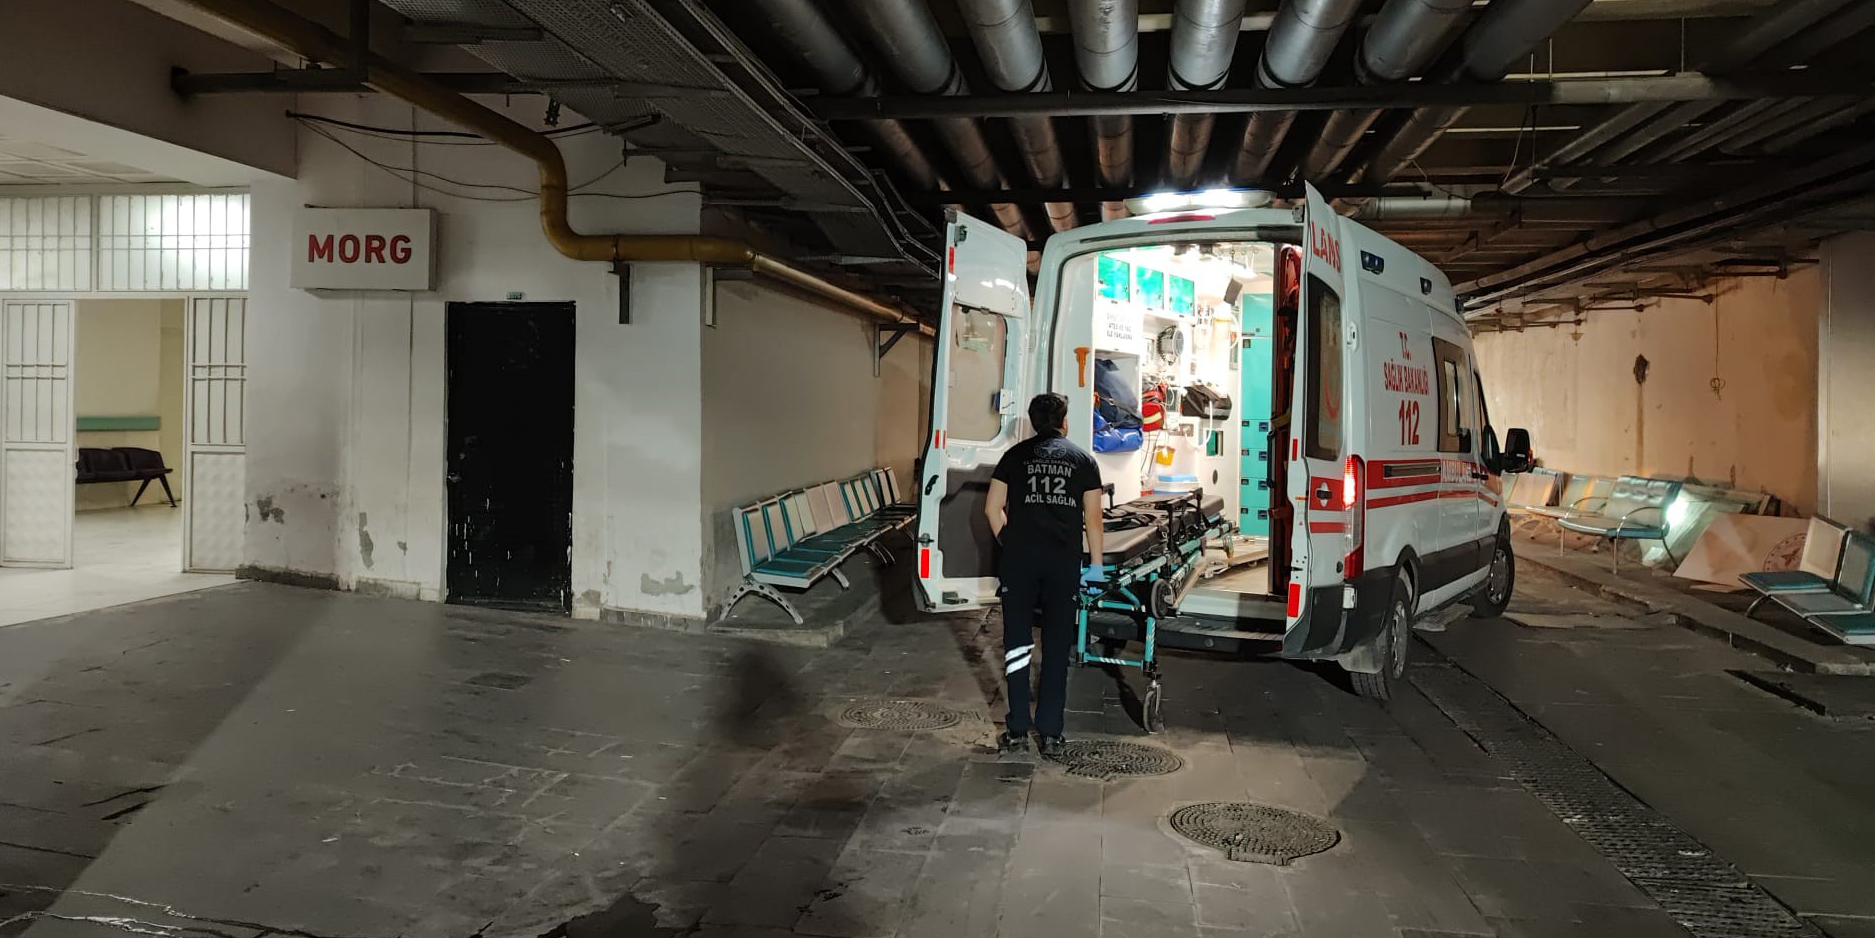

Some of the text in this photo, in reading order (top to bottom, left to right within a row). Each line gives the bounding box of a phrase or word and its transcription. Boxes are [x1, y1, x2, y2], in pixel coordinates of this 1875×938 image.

[308, 234, 412, 264] MORG
[1383, 358, 1429, 396] SAĞLIK BAKANLIĞI
[1398, 399, 1419, 445] 112
[1027, 464, 1072, 477] BATMAN
[1027, 475, 1066, 494] 112
[1024, 492, 1077, 507] ACİL SAĞLIK
